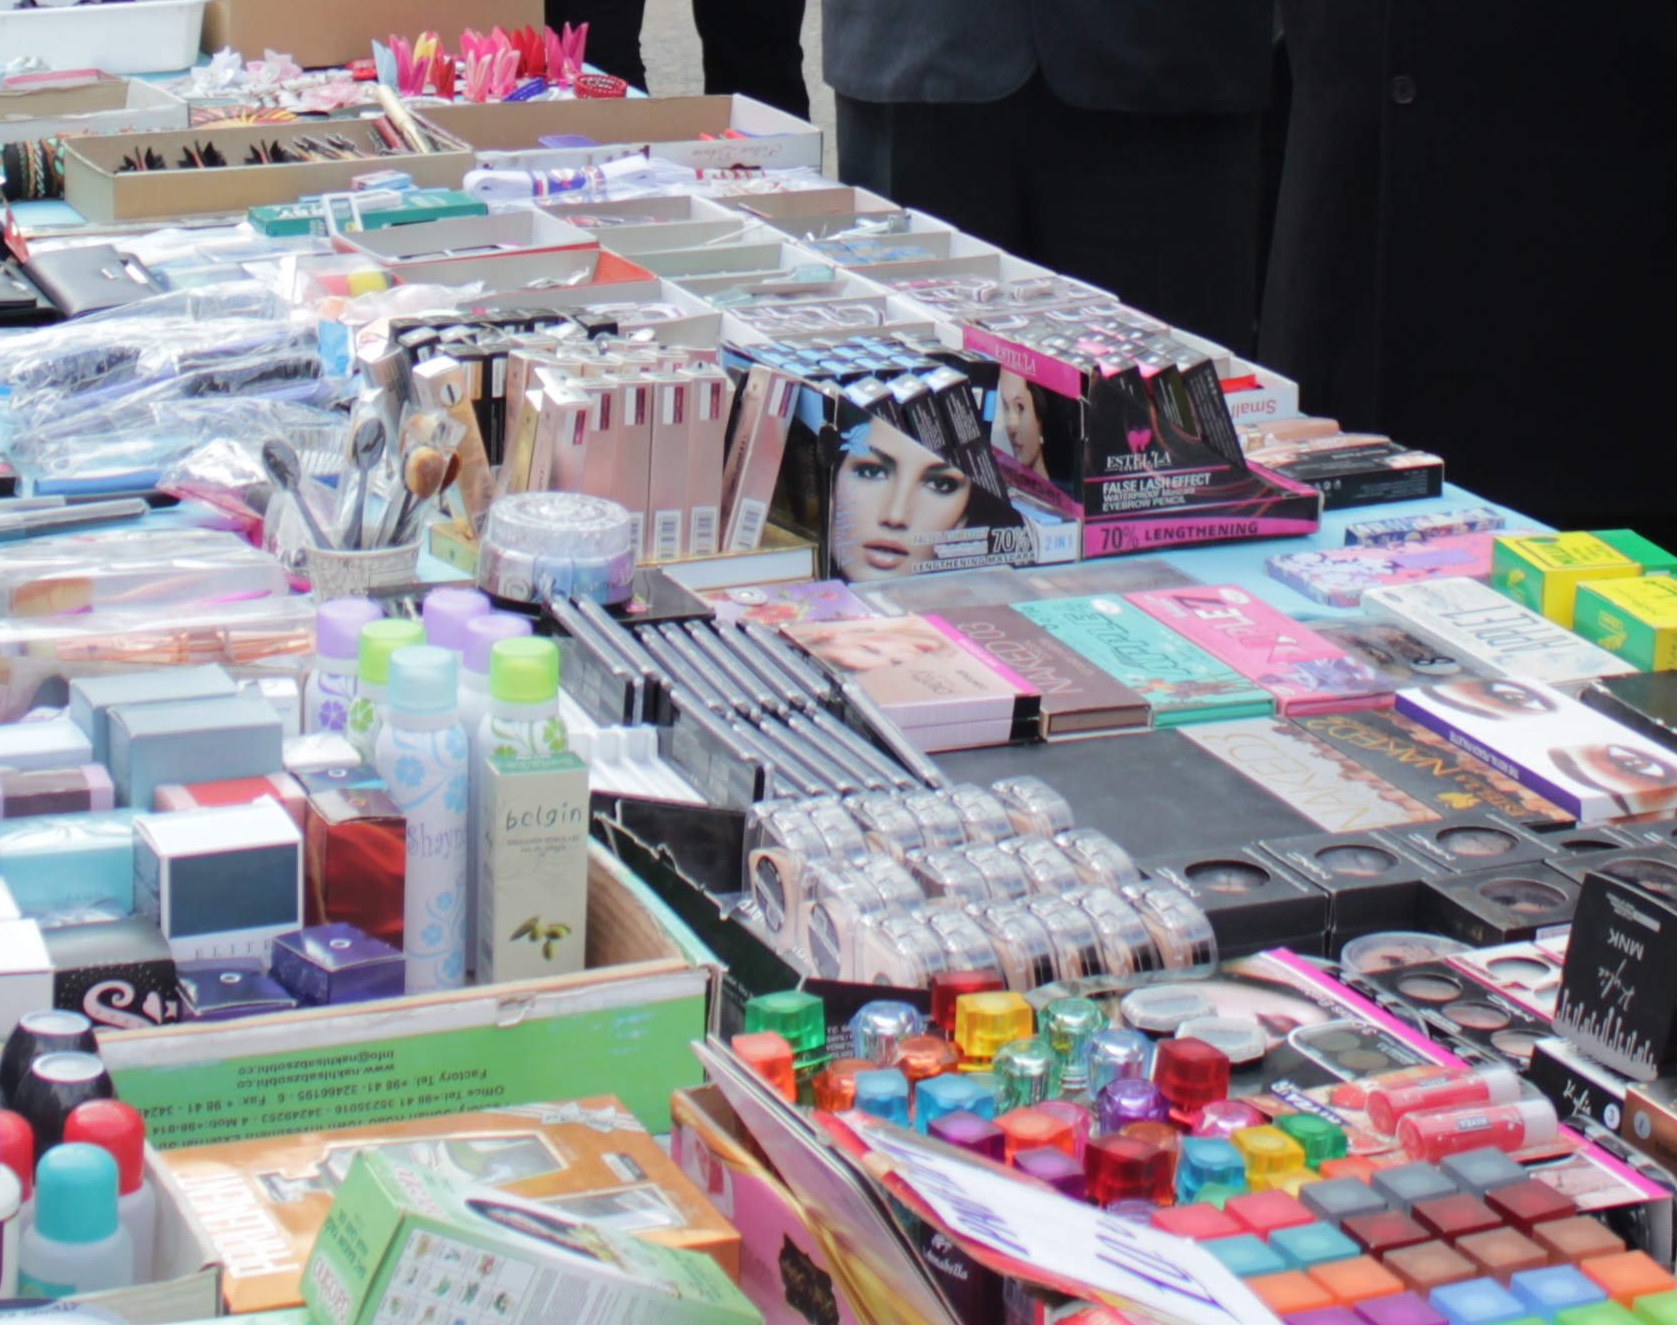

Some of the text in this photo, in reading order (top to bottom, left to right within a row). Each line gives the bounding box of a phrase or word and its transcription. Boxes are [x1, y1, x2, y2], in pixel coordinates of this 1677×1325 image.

[1230, 399, 1277, 417] Small
[1102, 472, 1212, 494] FALSE LASH EFFECT
[1102, 495, 1186, 511] EYEBROW PENCIL
[991, 527, 1031, 553] 70%
[1054, 535, 1066, 550] IN
[1100, 522, 1259, 551] 70% LENGTHENING
[913, 551, 1036, 572] LENGTHENING MASCARA
[439, 1068, 487, 1086] Factory
[240, 1094, 267, 1108] Fax:
[297, 1083, 358, 1103] 32466195
[466, 1084, 506, 1100] Office
[335, 1098, 396, 1117] 35235016
[399, 1097, 415, 1110] 41
[260, 1107, 323, 1125] 34249253
[1458, 1118, 1489, 1130] NIVEA
